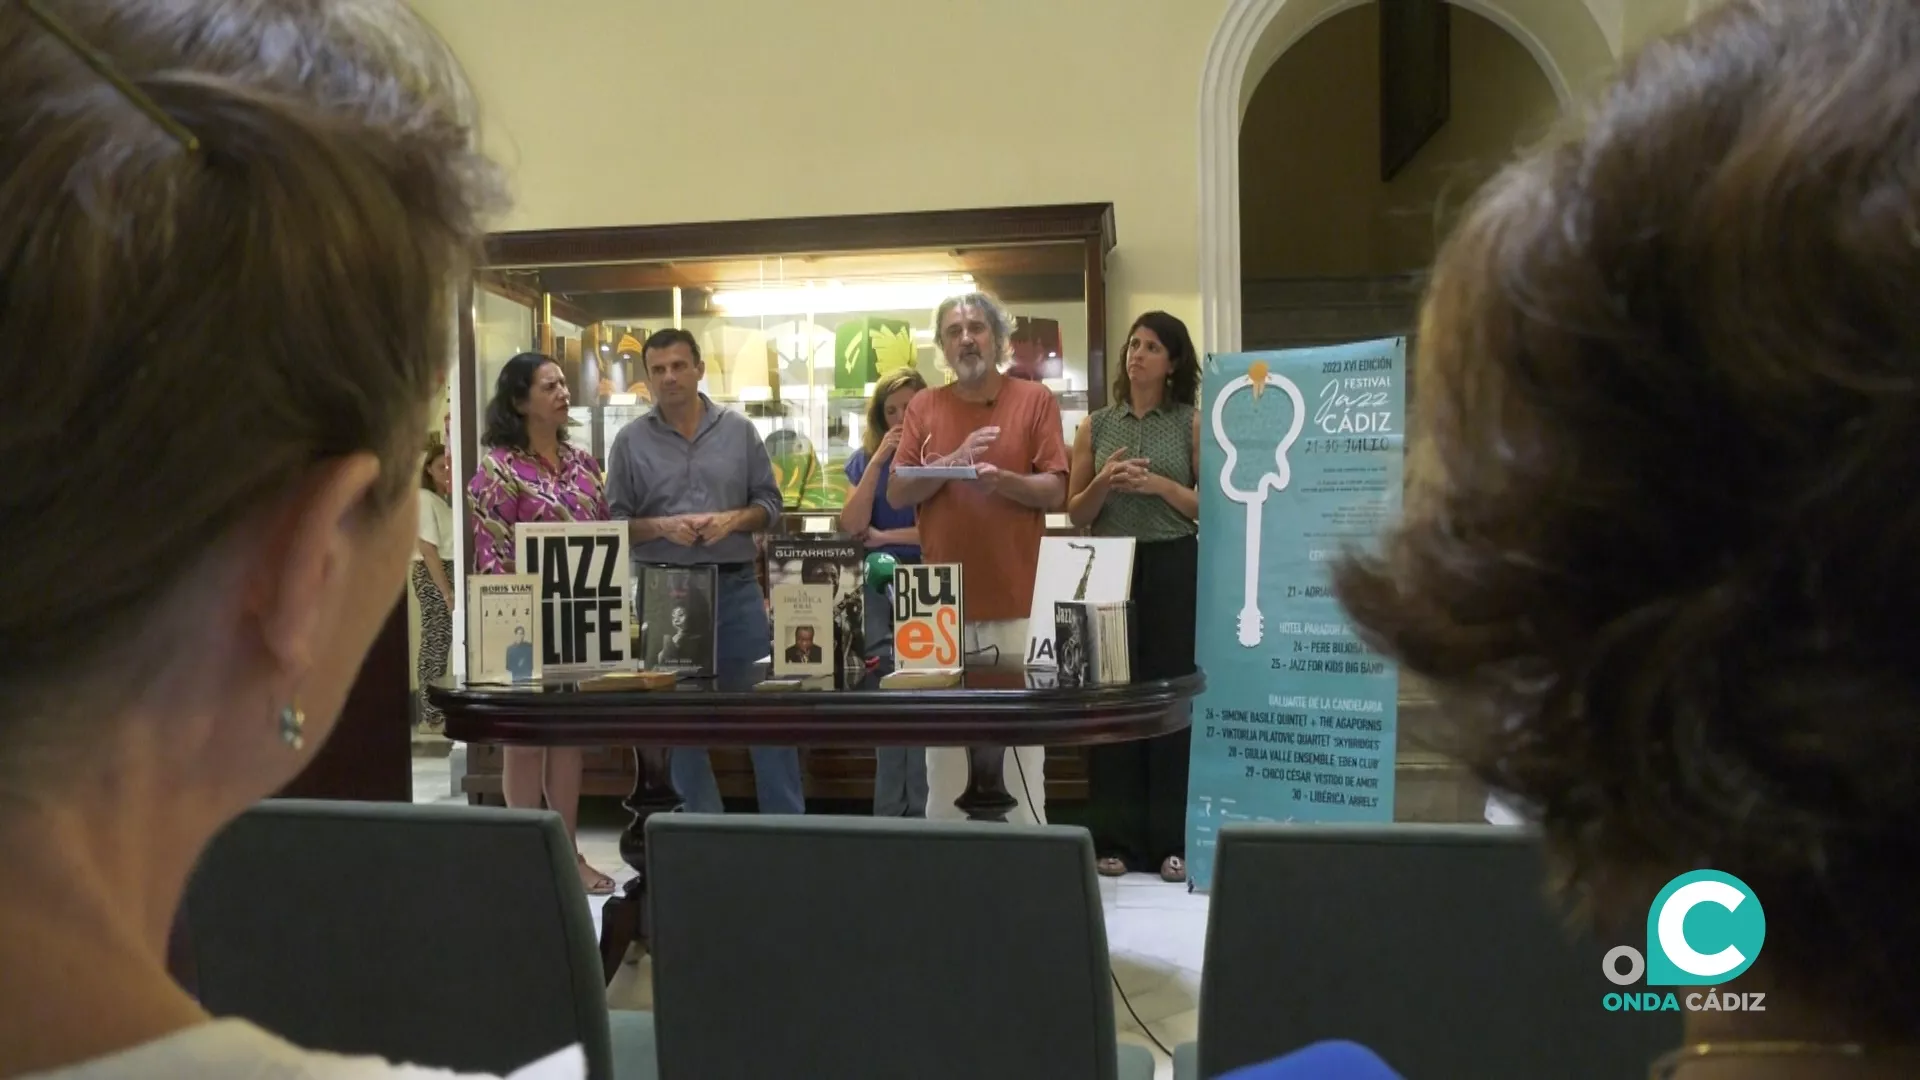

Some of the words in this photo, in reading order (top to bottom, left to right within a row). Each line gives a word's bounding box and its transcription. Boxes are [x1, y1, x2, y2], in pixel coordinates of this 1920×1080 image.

[1322, 361, 1341, 374] 2023
[1343, 360, 1357, 372] XVI
[1359, 356, 1392, 371] EDICIÓN
[1344, 376, 1391, 389] FESTIVAL
[1313, 378, 1389, 425] Jazz
[1322, 408, 1392, 434] CÁDIZ
[775, 548, 855, 558] GUITARRISTAS
[481, 584, 509, 593] BORIS
[511, 584, 532, 592] VIAN
[1287, 586, 1296, 598] 21
[1056, 605, 1073, 624] Jazz
[541, 600, 624, 665] LIFE
[1279, 622, 1302, 633] HOTEL
[1027, 636, 1055, 663] JA
[1311, 641, 1330, 653] PERE
[1271, 658, 1281, 669] 25
[1289, 658, 1306, 672] JAZZ
[1307, 660, 1323, 673] FOR
[1324, 660, 1344, 674] KIDS
[1345, 661, 1359, 674] BIG
[1360, 661, 1384, 675] BAND
[1268, 694, 1307, 709] BALUARTE
[1308, 697, 1320, 709] DE
[1320, 697, 1331, 709] LA
[1332, 698, 1383, 713] CANDELARIA
[1221, 709, 1249, 723] SIMONE
[1250, 711, 1276, 724] BASILE
[1277, 713, 1308, 727] QUINTET
[1319, 716, 1333, 729] THE
[1334, 717, 1382, 731] AGAPORNIS
[1206, 726, 1215, 738] 27
[1221, 728, 1258, 742] VIKTORIJA
[1296, 733, 1331, 748] QUARTET
[1244, 747, 1268, 760] GIULIA
[1269, 749, 1293, 763] VALLE
[1293, 751, 1335, 767] ENSEMBLE
[1245, 765, 1255, 777] 29
[1262, 767, 1285, 781] CHICO
[1286, 768, 1311, 783] CÉSAR
[1345, 775, 1355, 788] DE
[1292, 788, 1302, 801] 30
[1309, 790, 1345, 805] LIBÉRICA
